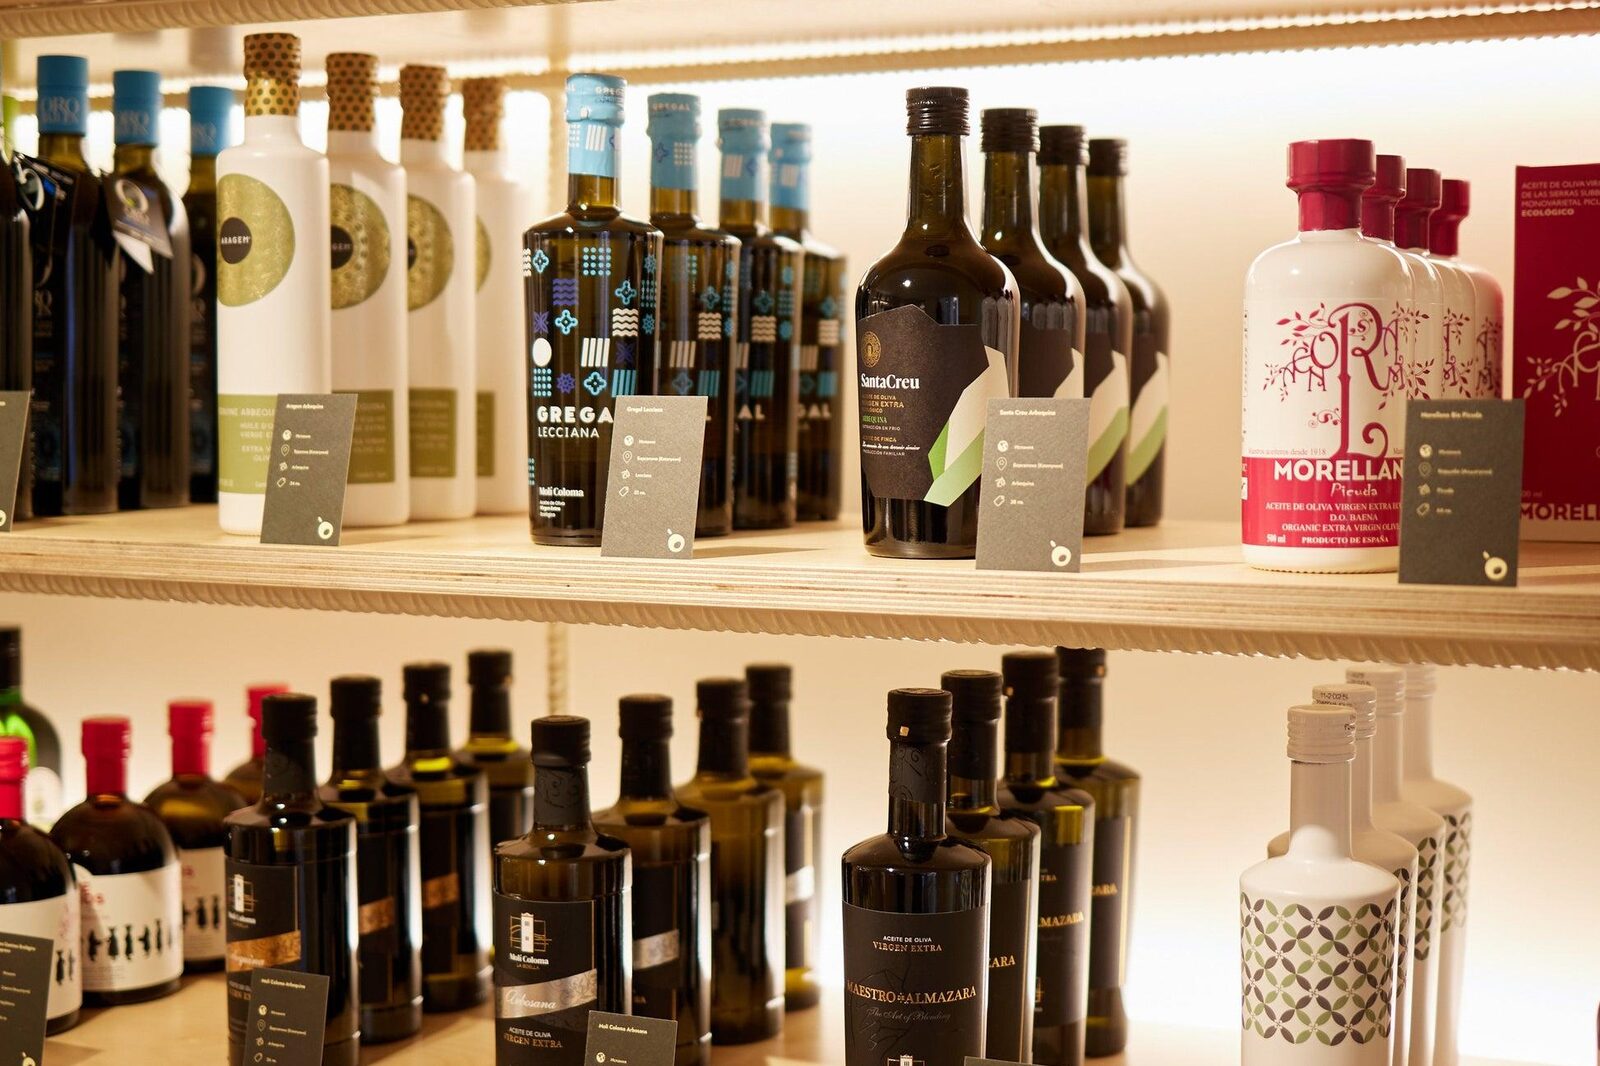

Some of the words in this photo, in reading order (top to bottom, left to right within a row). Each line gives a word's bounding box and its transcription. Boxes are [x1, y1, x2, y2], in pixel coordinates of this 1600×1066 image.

[861, 373, 920, 389] SantaCreu
[537, 406, 614, 423] GREGA
[538, 427, 600, 438] LECCIANA
[1274, 459, 1404, 481] MORELLAN
[553, 487, 584, 497] Coloma
[1331, 482, 1378, 497] Picuda
[1265, 502, 1291, 510] ACEITE
[1306, 503, 1333, 511] OLIVA
[1335, 502, 1367, 511] VIRGEN
[1369, 502, 1391, 510] EXTRA
[1282, 524, 1321, 532] ORGANIC
[1323, 524, 1352, 532] EXTRA
[1354, 523, 1382, 532] VIRGIN
[1302, 536, 1348, 544] PRODUCTO
[1362, 534, 1389, 544] ESPAÑA
[1040, 912, 1084, 928] MAZARA
[883, 935, 903, 943] ACEITE
[873, 941, 908, 952] VIRGEN
[911, 944, 942, 952] EXTRA
[523, 954, 549, 965] Coloma
[847, 980, 896, 1003] MAESTRO
[905, 986, 976, 1004] ALMAZARA
[509, 1026, 525, 1036] ACEITE
[526, 1029, 535, 1037] DE
[536, 1030, 551, 1039] OLIVA
[609, 1024, 626, 1032] Coloma
[532, 1037, 562, 1049] EXTRA
